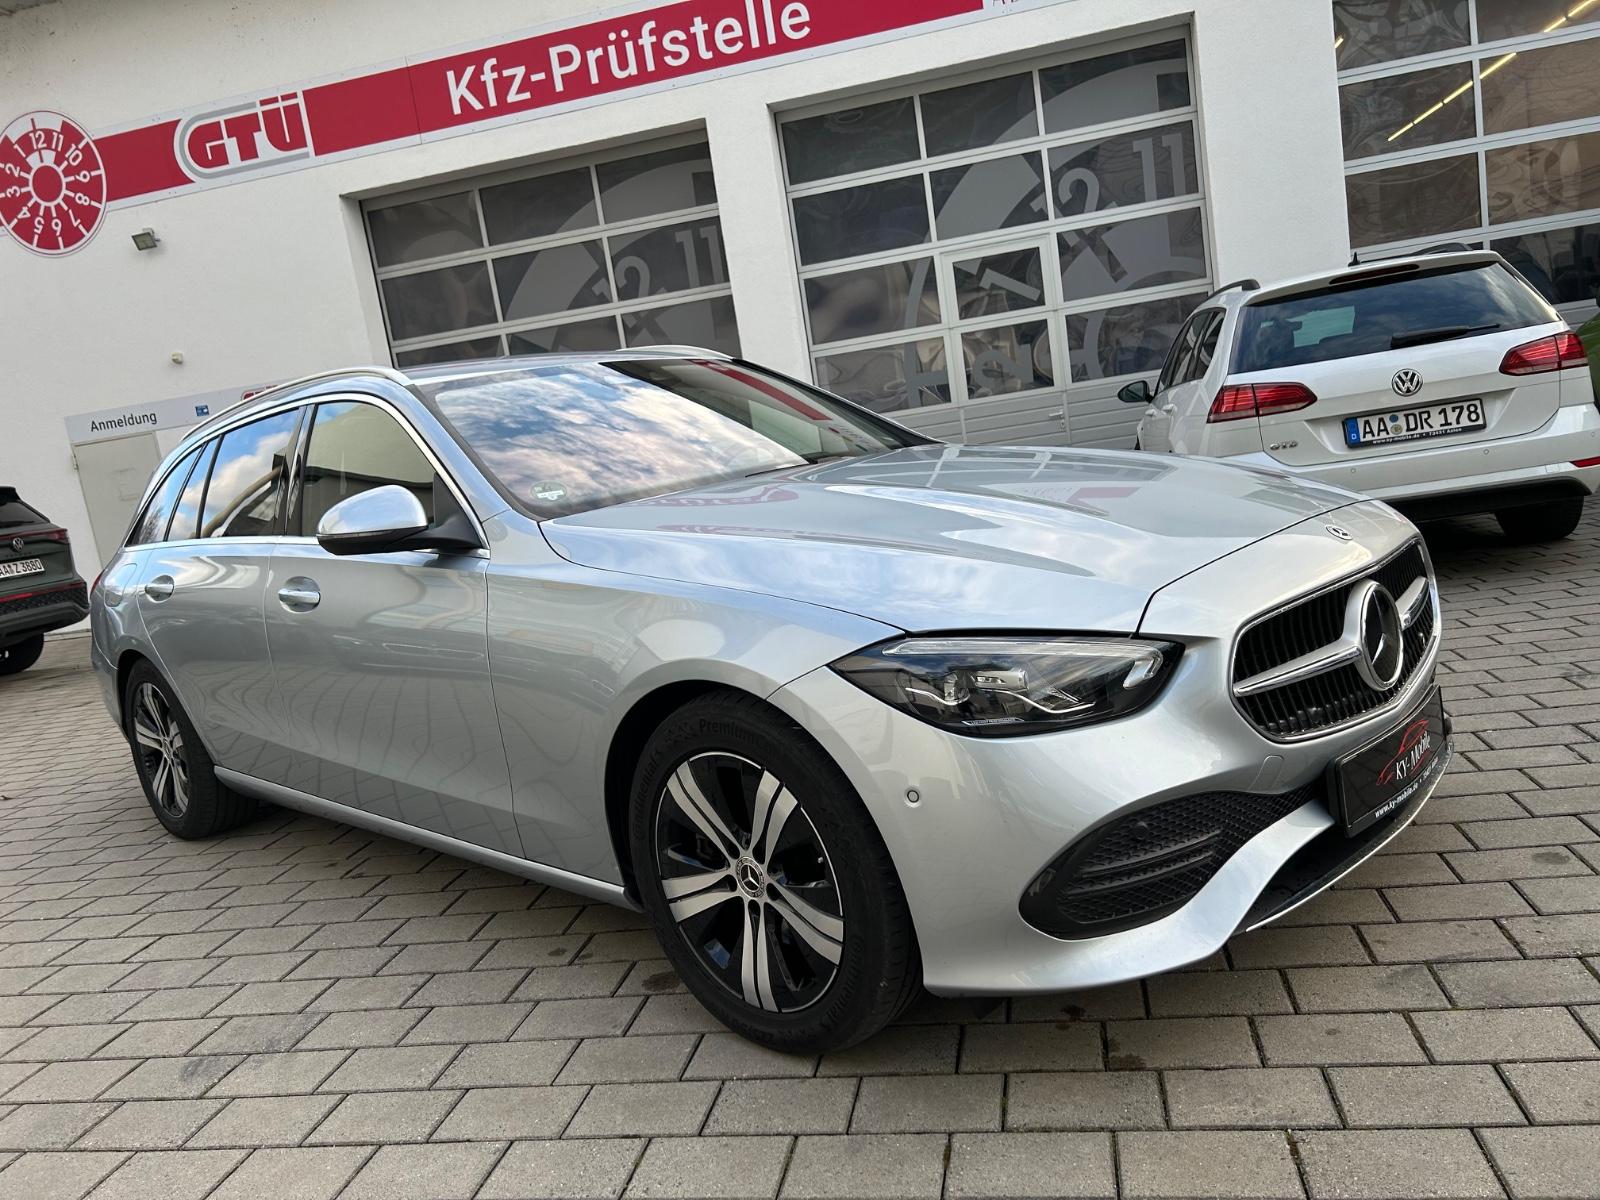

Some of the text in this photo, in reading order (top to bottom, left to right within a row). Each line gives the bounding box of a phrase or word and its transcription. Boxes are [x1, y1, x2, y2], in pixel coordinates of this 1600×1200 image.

[446, 0, 811, 115] Kfz-Prüfstelle
[187, 92, 308, 169] GTÜ
[29, 131, 47, 150] 12
[52, 132, 64, 151] 11
[65, 143, 83, 166] 10
[5, 163, 20, 178] 2
[6, 186, 21, 198] 3
[75, 193, 90, 206] 8
[17, 206, 31, 219] 4
[34, 217, 45, 235] 5
[90, 412, 157, 432] Anmeldung
[1362, 417, 1389, 439] AA
[1403, 410, 1434, 432] DR
[1438, 404, 1480, 427] 178
